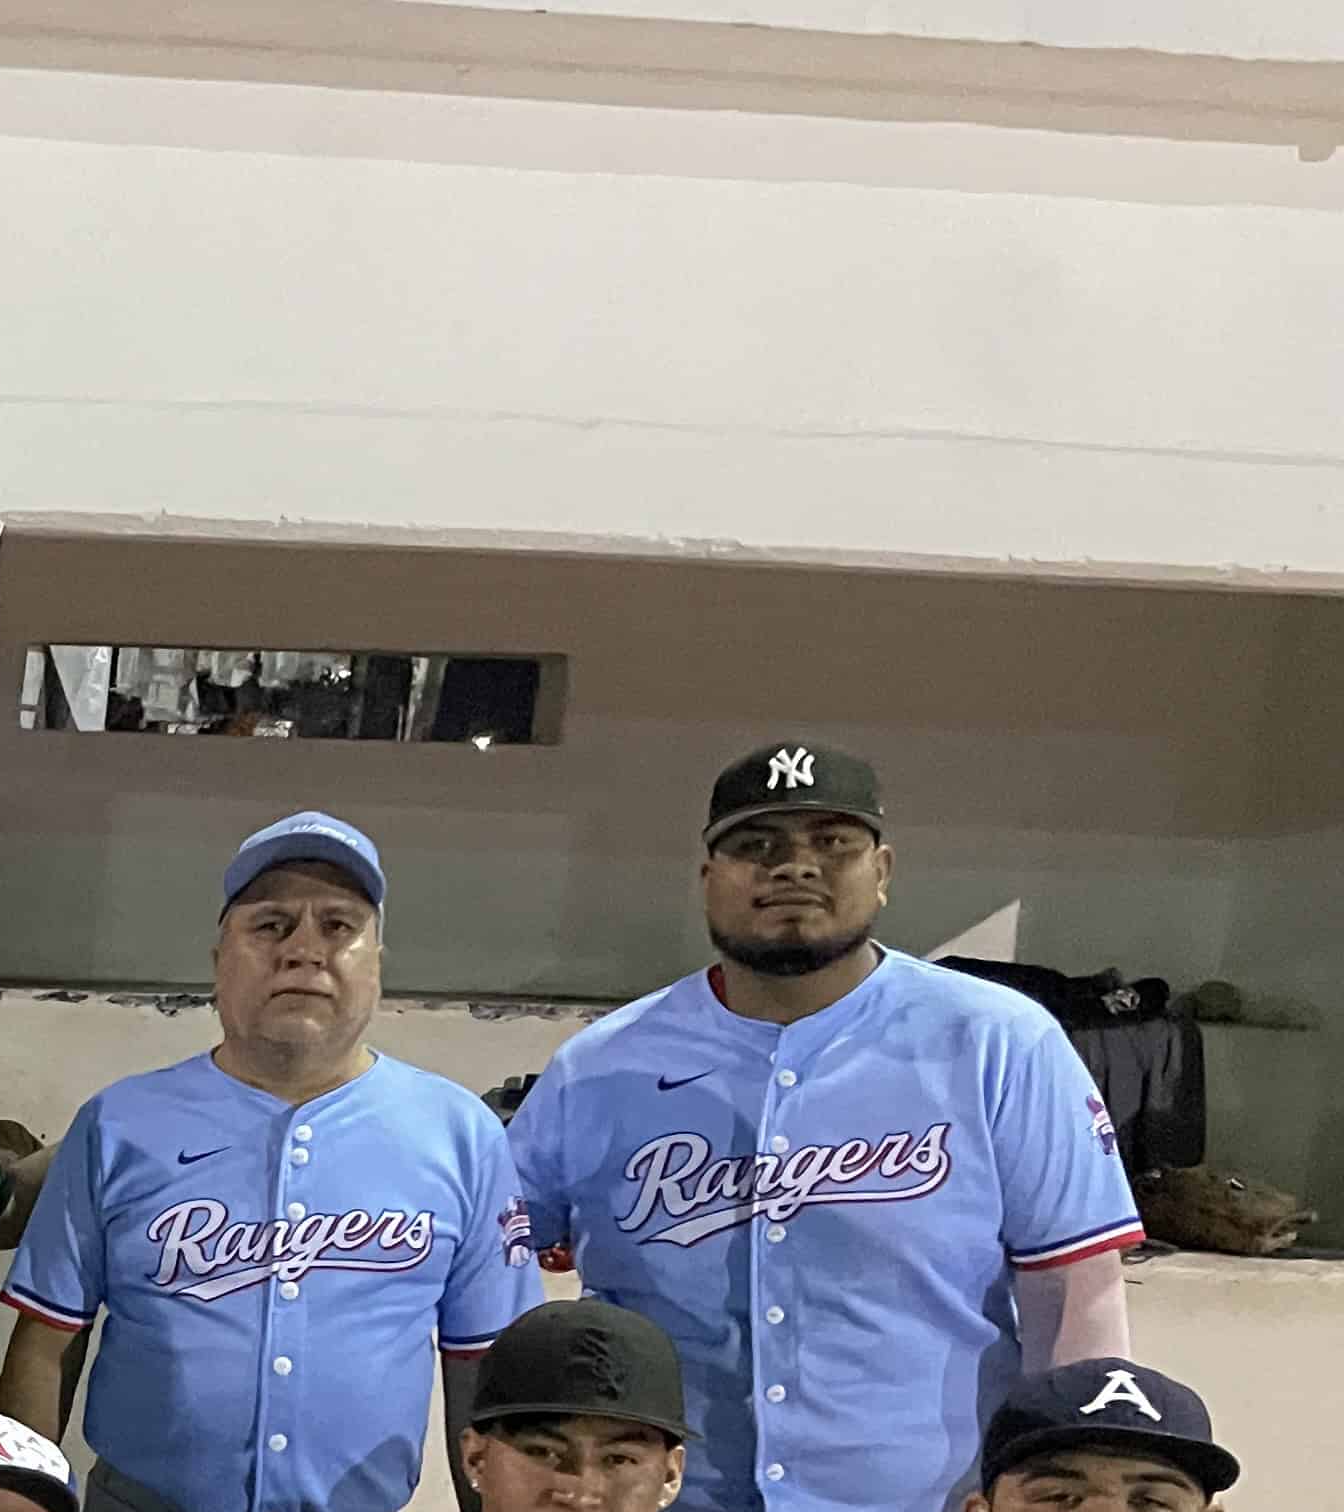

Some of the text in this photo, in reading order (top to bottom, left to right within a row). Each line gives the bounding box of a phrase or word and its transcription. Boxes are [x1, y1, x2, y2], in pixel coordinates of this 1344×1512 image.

[766, 746, 816, 790] NY
[615, 1122, 952, 1232] Rangers
[144, 1198, 434, 1286] Rangers
[1079, 1369, 1162, 1423] A
